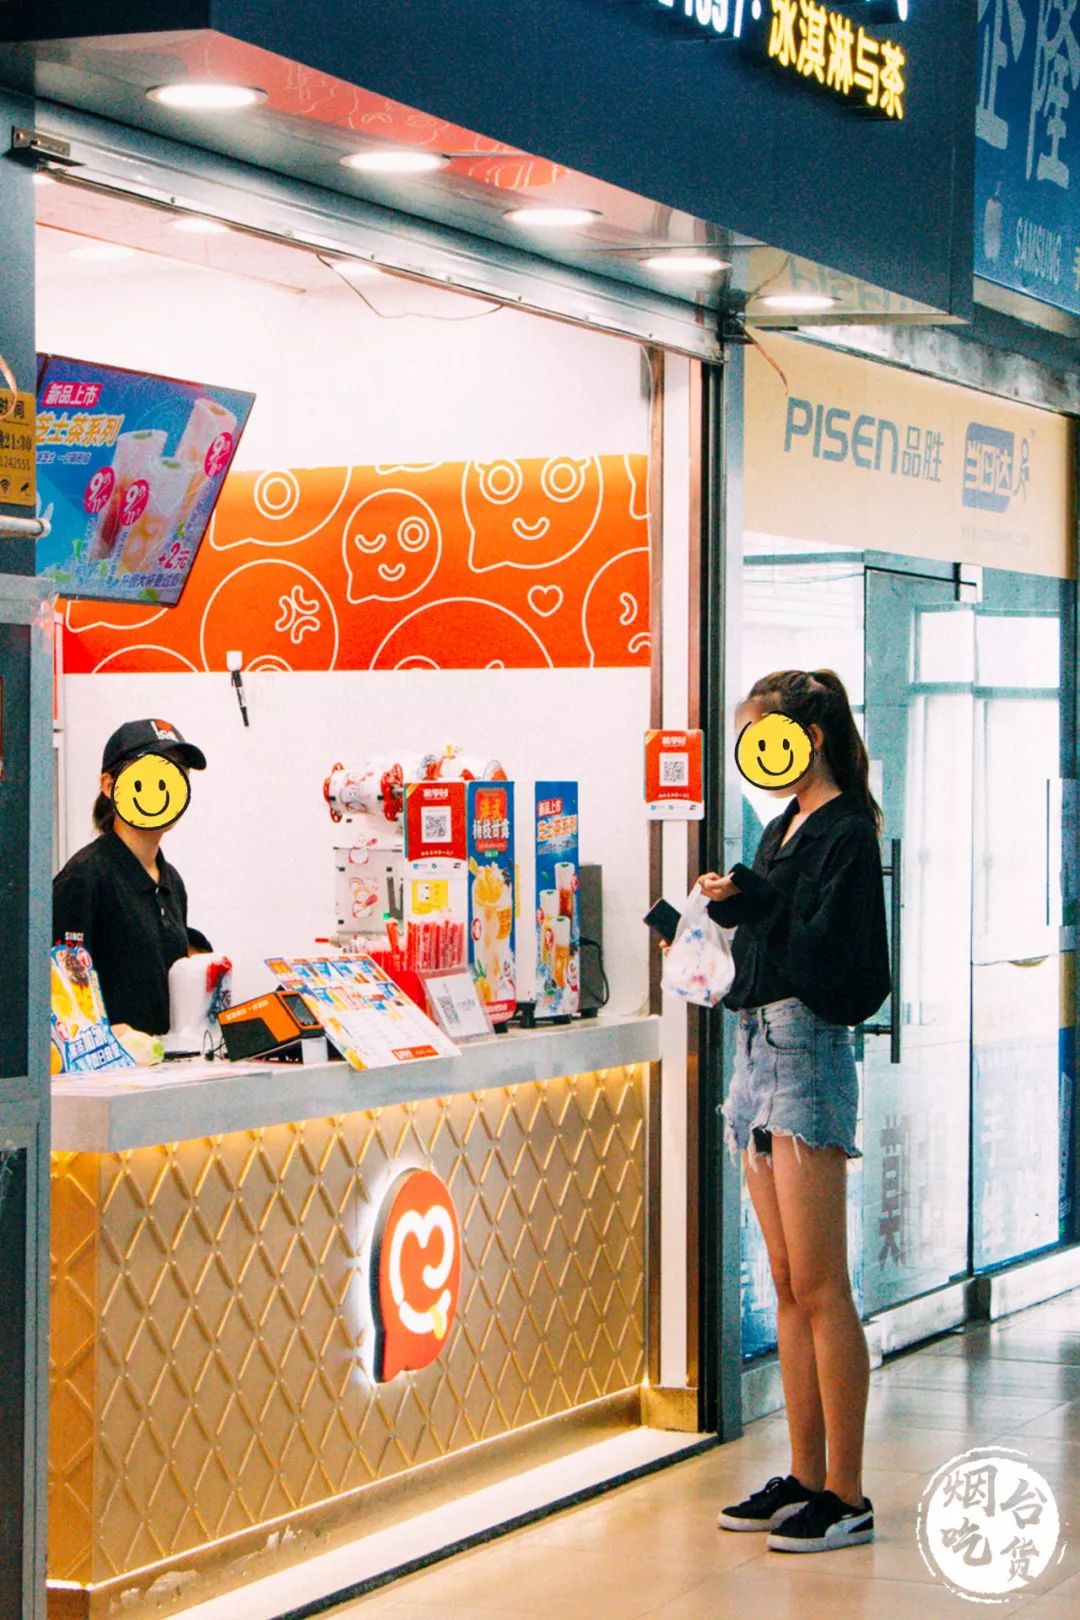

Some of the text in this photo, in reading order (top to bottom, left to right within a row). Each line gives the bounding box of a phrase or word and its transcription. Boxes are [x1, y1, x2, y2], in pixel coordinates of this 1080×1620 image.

[768, 0, 905, 120] 冰淇淋与茶
[1014, 216, 1062, 286] SAMSUNG
[45, 383, 100, 406] 新品上市
[901, 425, 944, 483] 品胜
